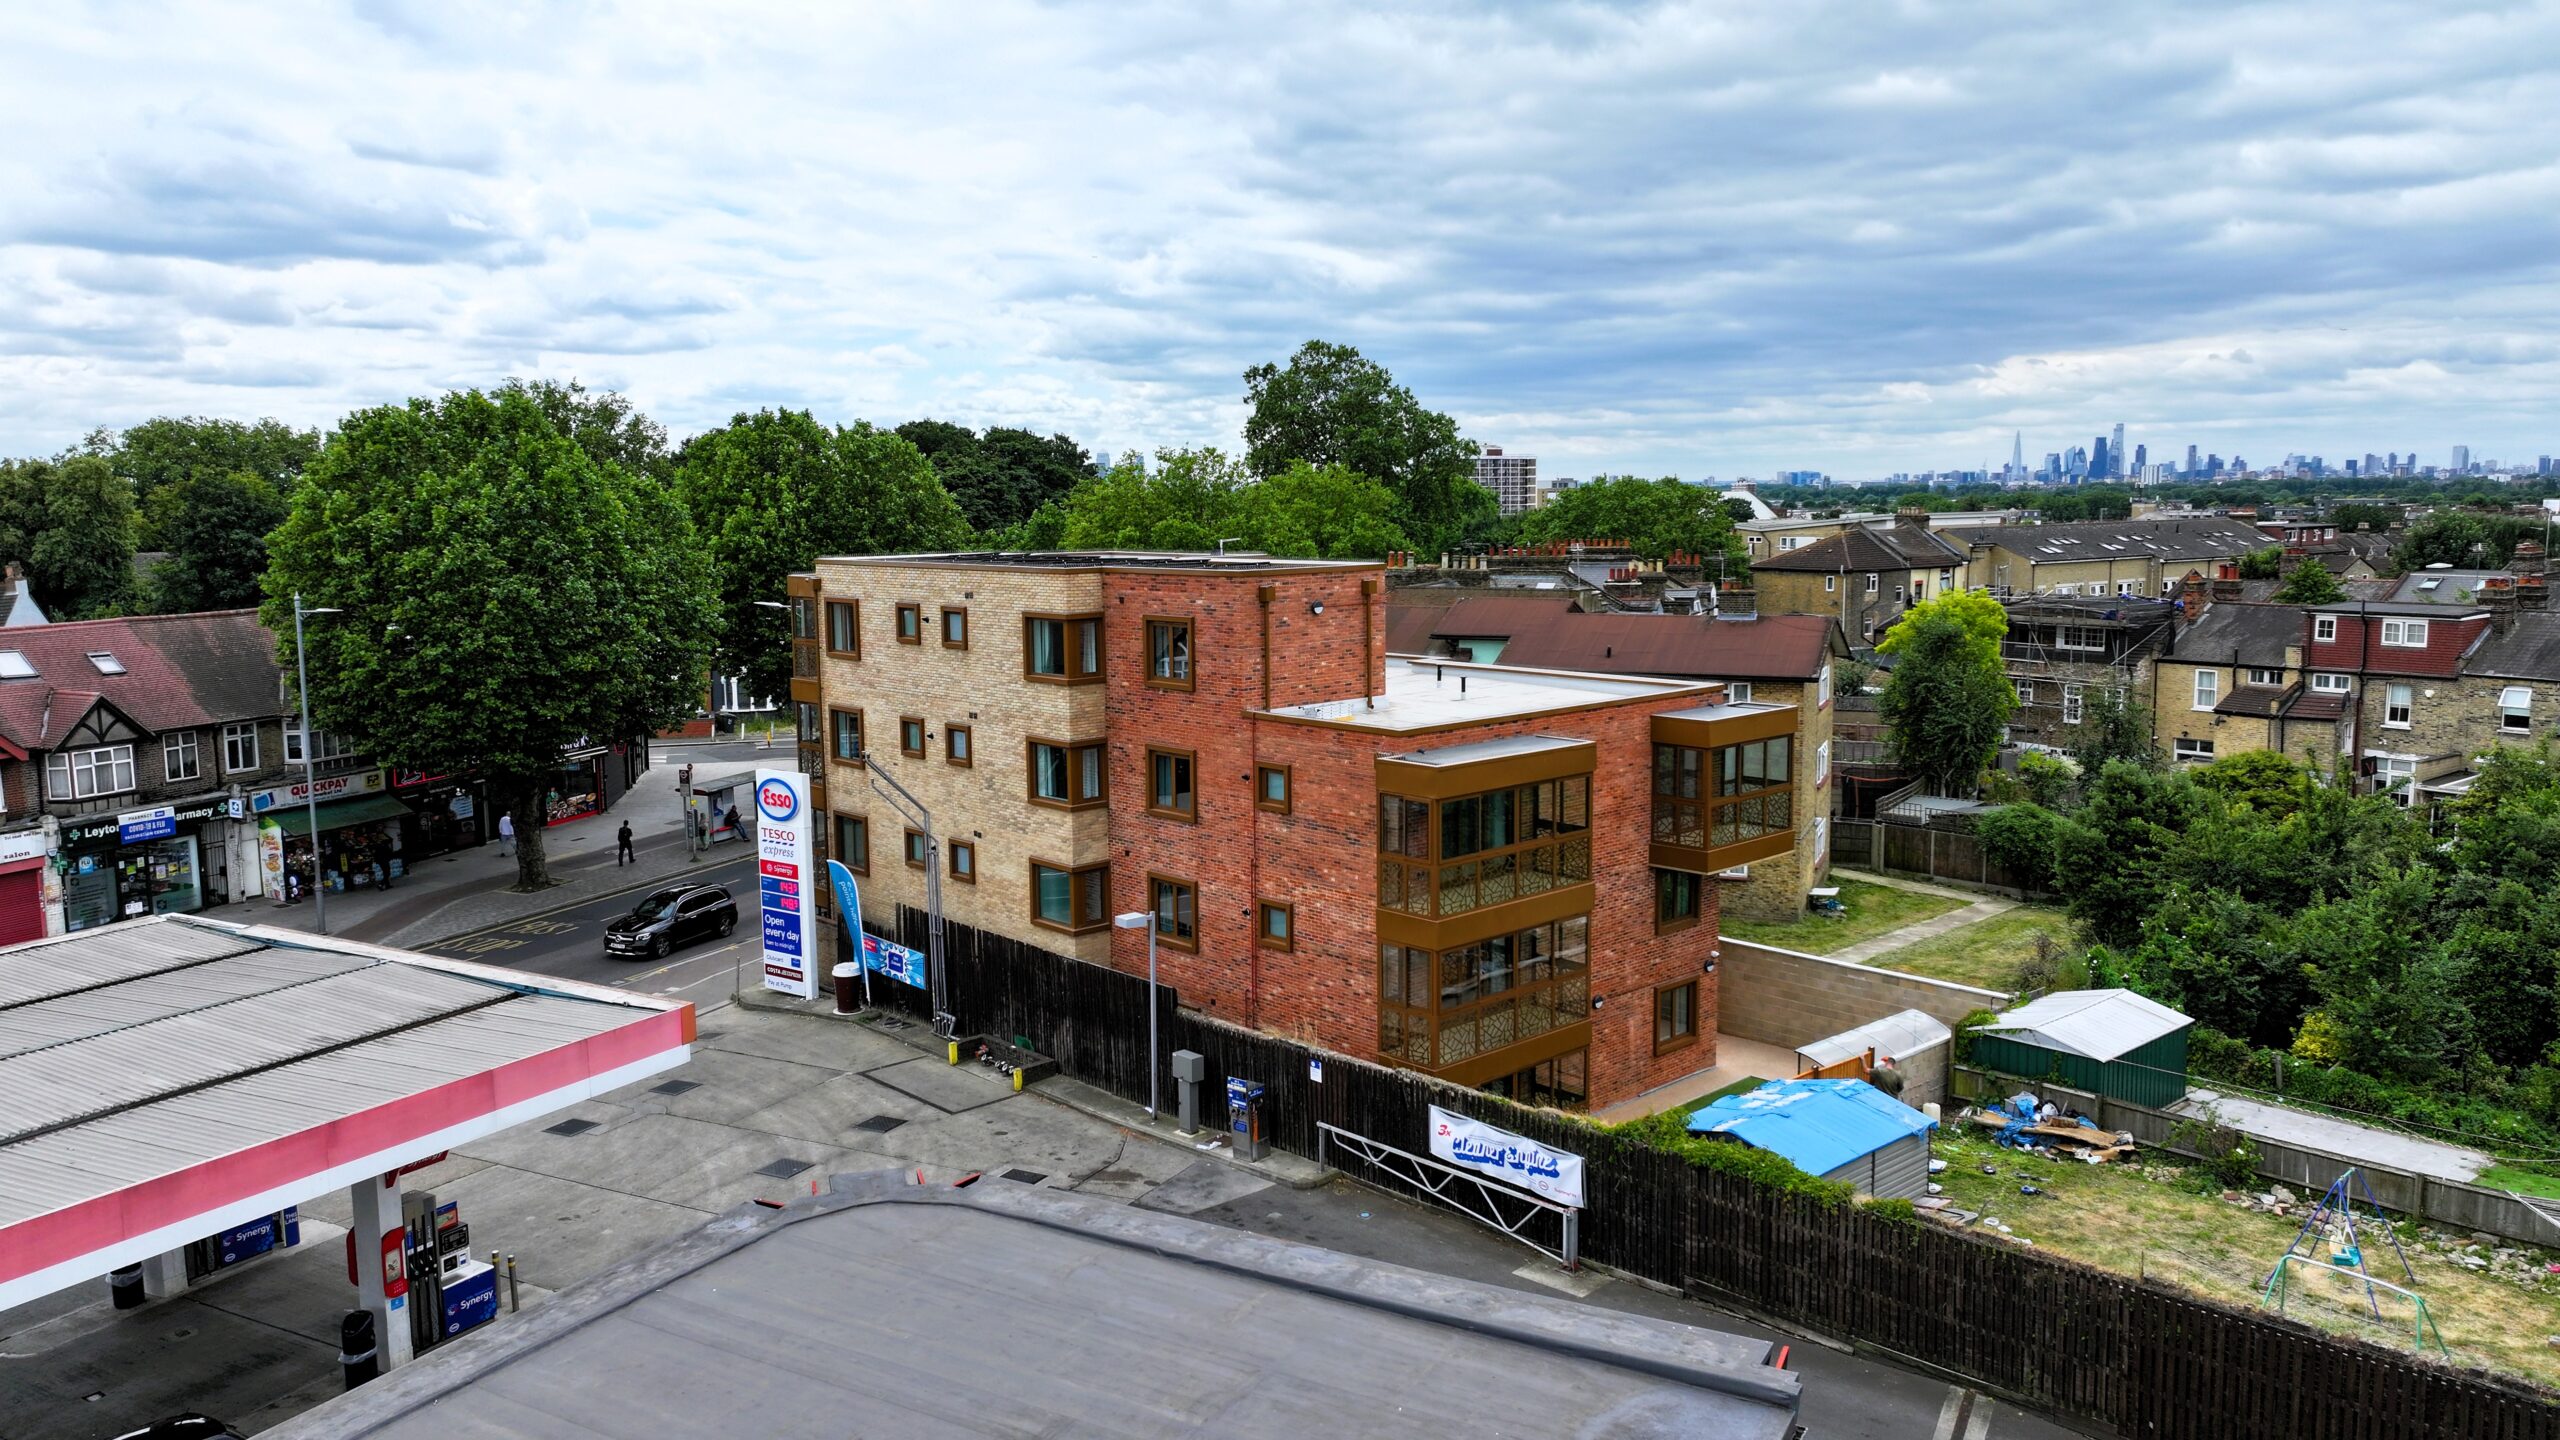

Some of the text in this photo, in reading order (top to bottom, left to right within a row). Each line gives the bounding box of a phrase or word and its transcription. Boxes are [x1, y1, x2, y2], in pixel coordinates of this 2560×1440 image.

[291, 778, 348, 796] QUCKPAY
[763, 788, 792, 809] Esso
[175, 807, 213, 821] armacy
[761, 827, 795, 842] TESCO
[4, 850, 30, 859] salon
[763, 846, 794, 858] express
[774, 864, 793, 877] Synergy
[764, 914, 785, 926] Open
[765, 928, 800, 943] every day
[779, 942, 796, 951] midnight
[767, 966, 781, 974] COSTA
[780, 981, 792, 990] Pump
[1438, 1124, 1451, 1137] 3x
[285, 1211, 297, 1220] THIS
[286, 1217, 298, 1225] LANE
[236, 1224, 271, 1242] Synergy
[460, 1290, 494, 1310] Synergy
